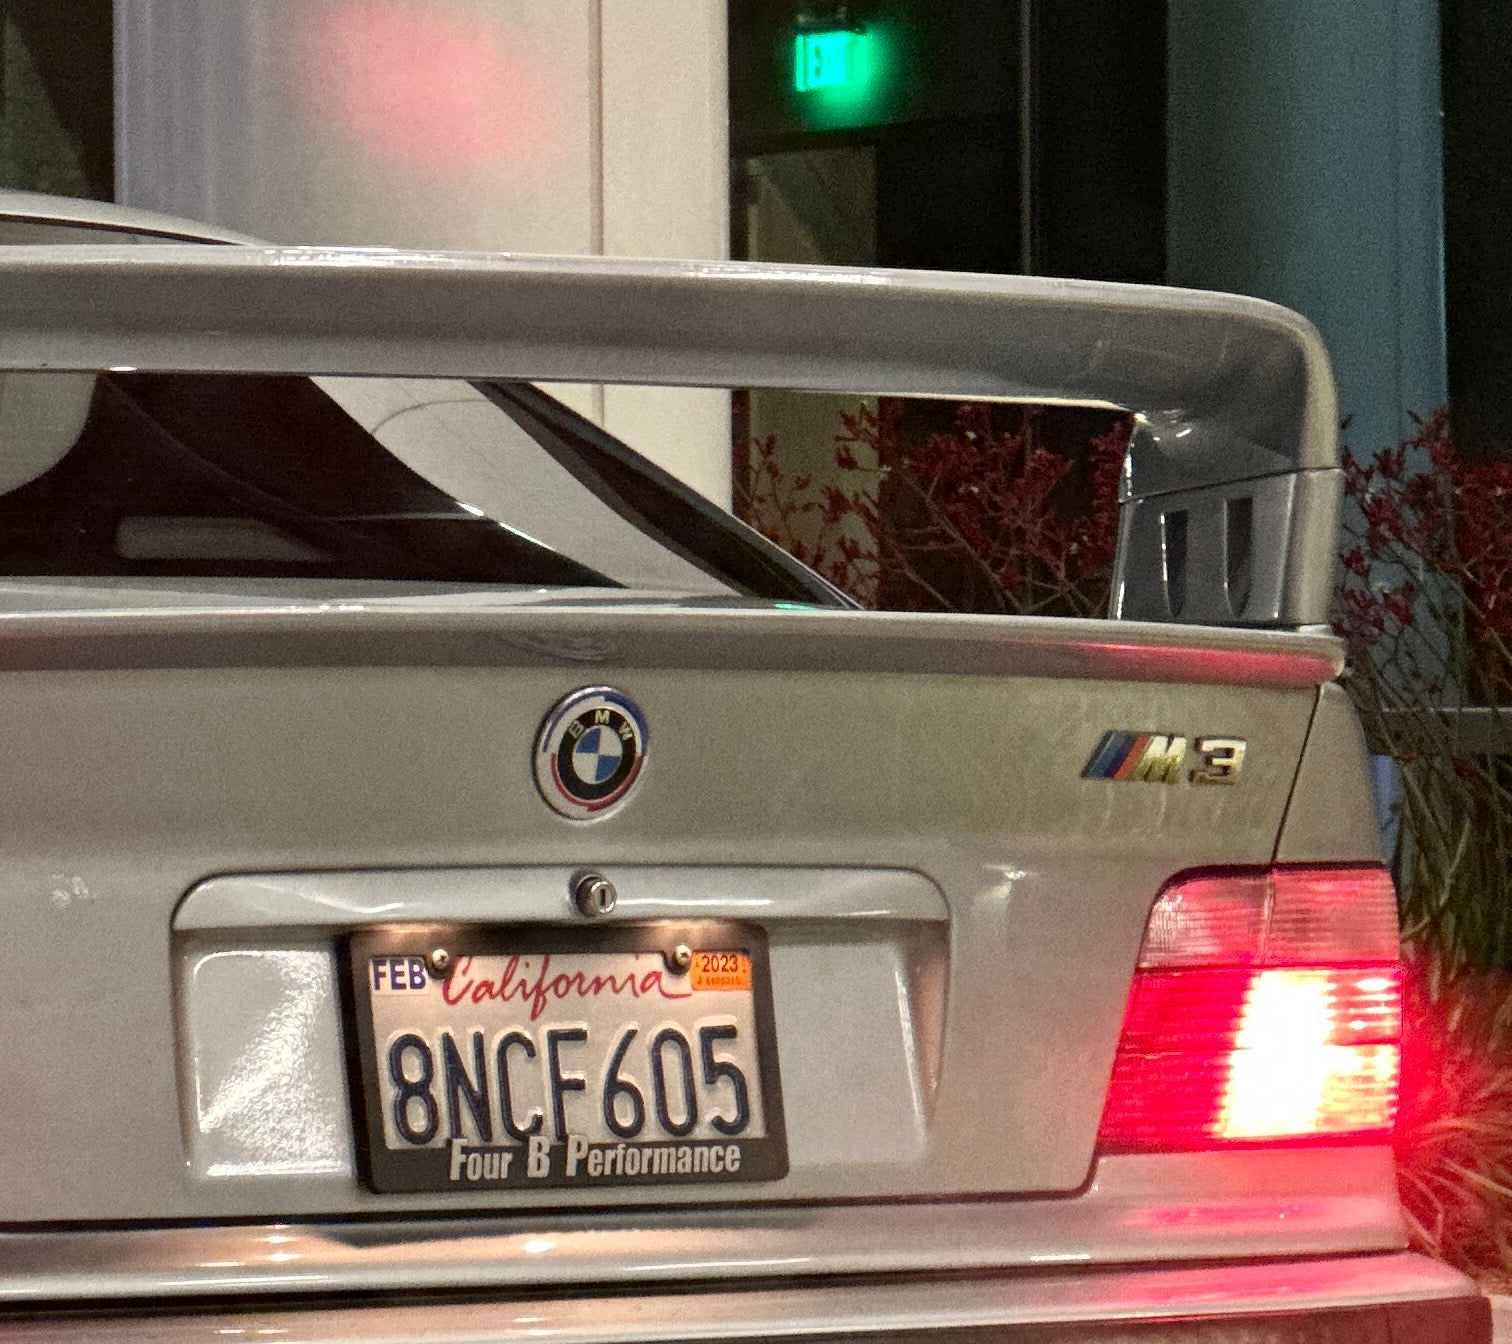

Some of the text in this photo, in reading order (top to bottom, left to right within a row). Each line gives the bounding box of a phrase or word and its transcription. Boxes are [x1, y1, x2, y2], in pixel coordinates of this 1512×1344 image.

[568, 709, 633, 741] BMW
[372, 959, 426, 990] FEB
[701, 953, 739, 973] 2023
[442, 955, 692, 1021] California
[389, 1024, 750, 1146] 8NCF605
[449, 1134, 742, 1181] Four B Performance
